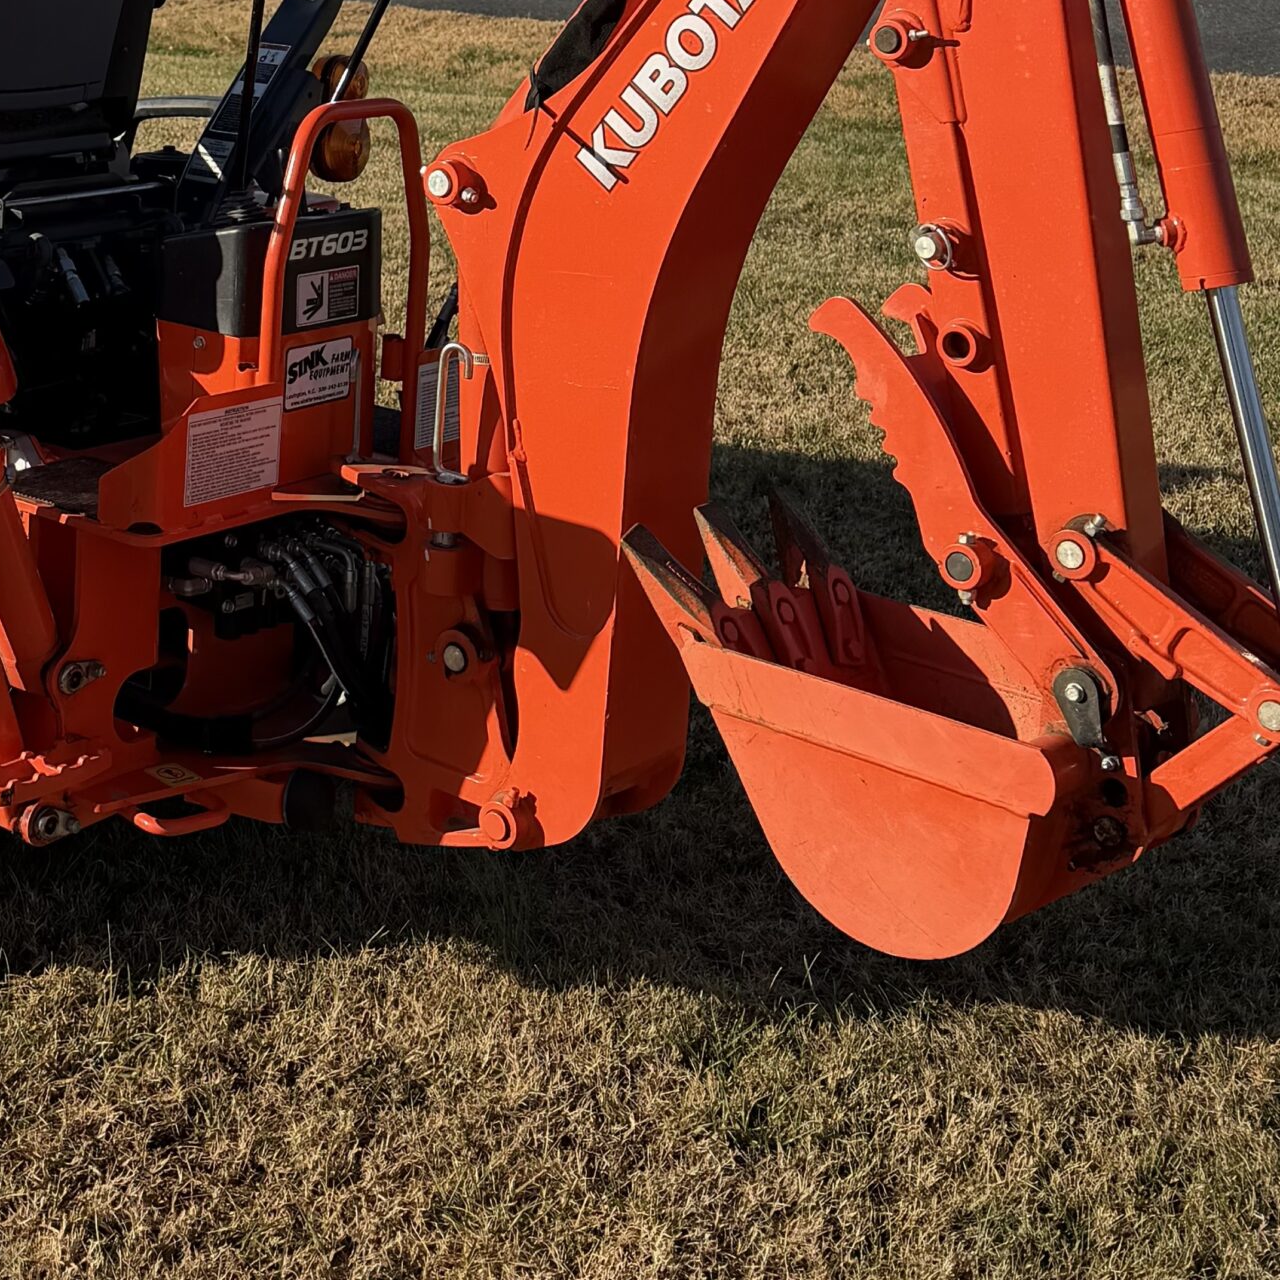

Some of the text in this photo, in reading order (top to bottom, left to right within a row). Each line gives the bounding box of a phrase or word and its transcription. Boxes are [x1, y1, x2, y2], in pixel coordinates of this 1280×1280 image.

[289, 229, 368, 261] BT603
[288, 344, 351, 384] SINK FARM
[310, 363, 350, 381] EQUIPMENT
